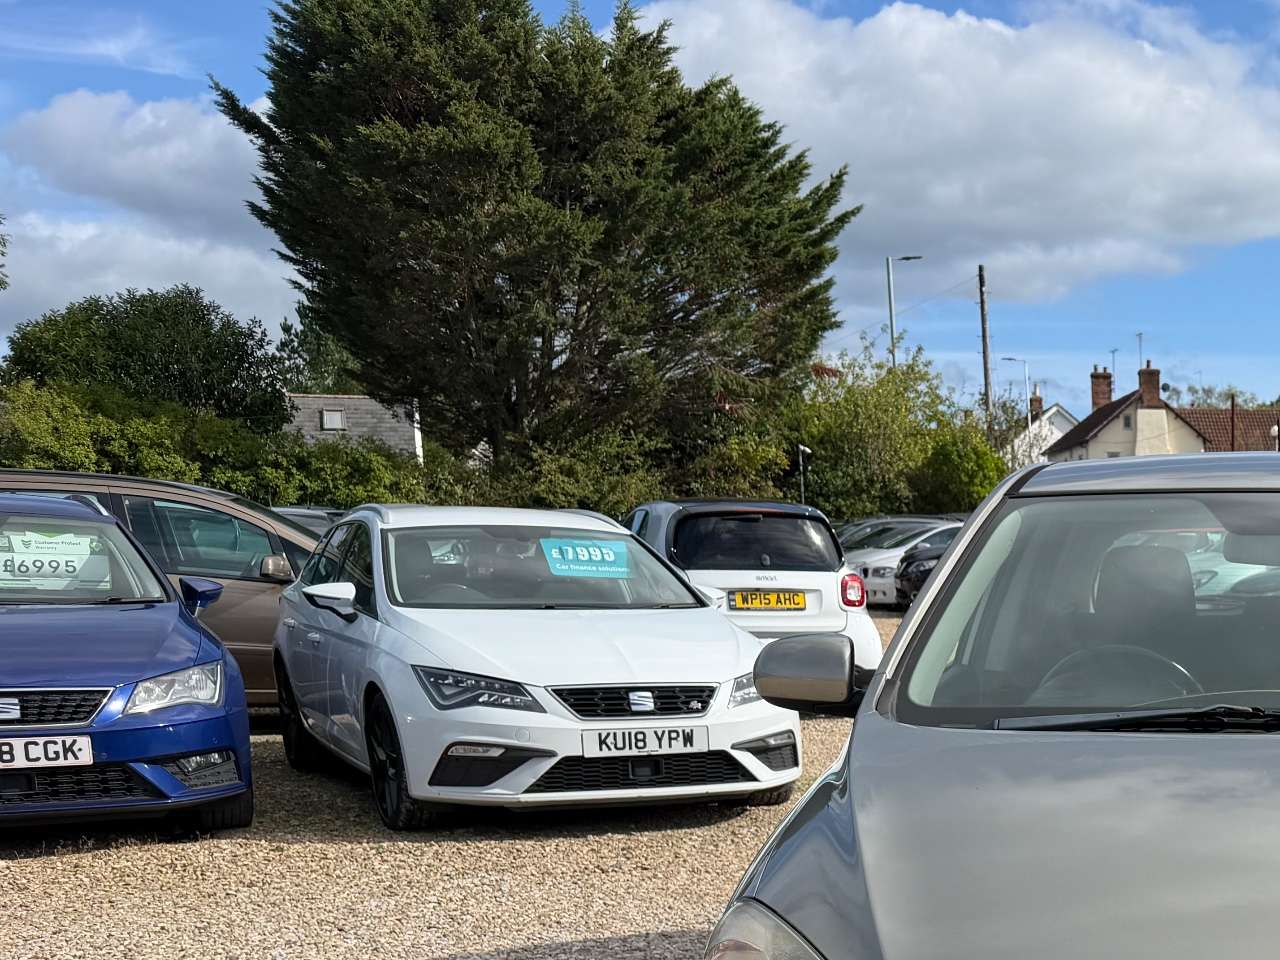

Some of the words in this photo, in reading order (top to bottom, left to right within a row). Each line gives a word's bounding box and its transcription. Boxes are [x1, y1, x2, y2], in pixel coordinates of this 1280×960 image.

[3, 559, 77, 575] £6995
[740, 592, 771, 606] WP15
[776, 593, 801, 606] AHC
[598, 731, 647, 752] KU18
[654, 729, 695, 750] YPW
[24, 739, 80, 763] CGK
